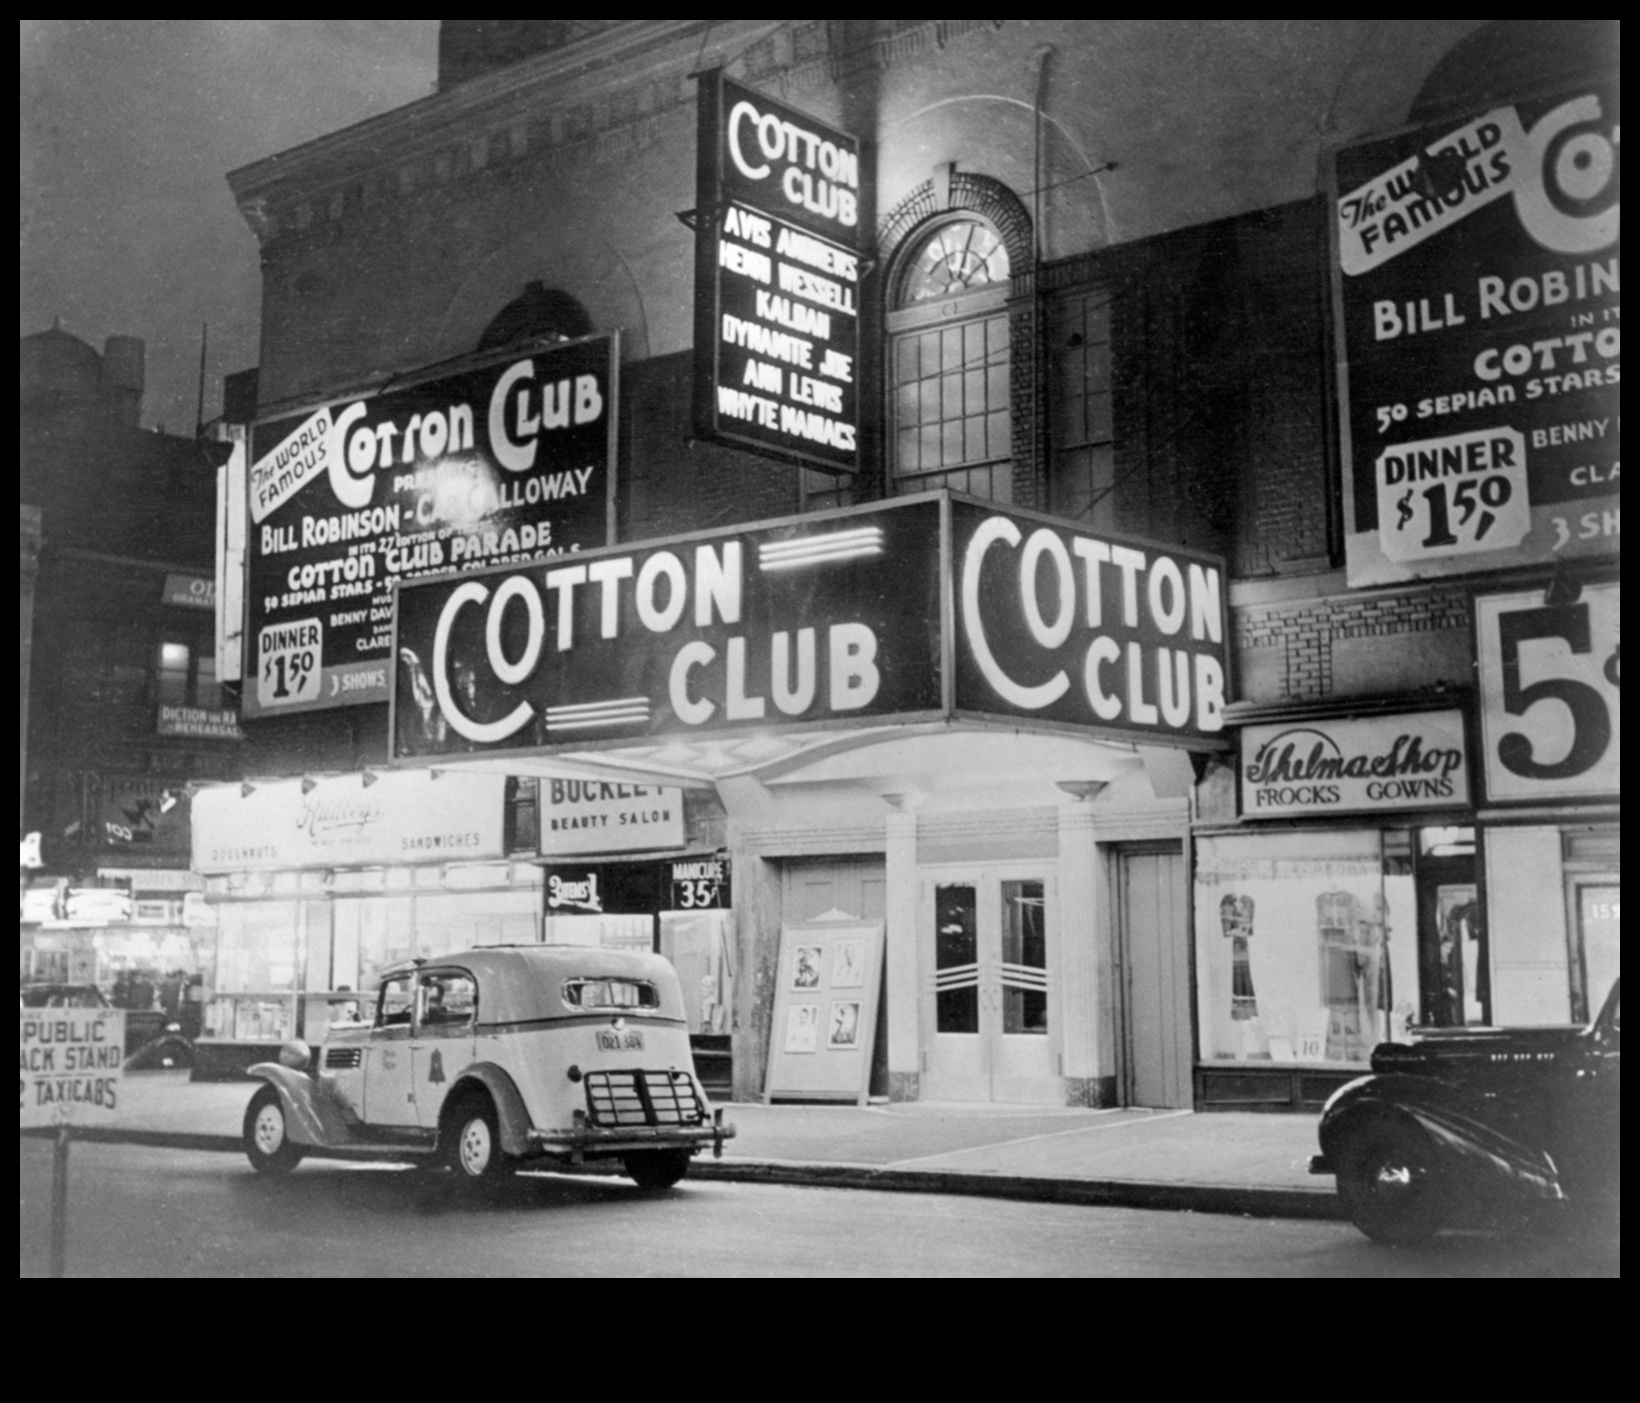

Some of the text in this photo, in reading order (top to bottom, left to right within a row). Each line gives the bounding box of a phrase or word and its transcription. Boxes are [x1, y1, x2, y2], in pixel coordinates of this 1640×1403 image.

[728, 100, 858, 188] COTTON
[783, 166, 858, 226] CLUB
[1340, 123, 1502, 229] The WLD
[1514, 95, 1620, 253] CO
[723, 207, 772, 248] AVIS
[1373, 258, 1620, 341] BILL ROBIN
[1571, 312, 1594, 328] IN
[722, 313, 853, 383] DYNAMITE JOE
[1474, 327, 1620, 381] COTTO
[717, 386, 779, 430] WHYTE
[743, 358, 843, 414] ANN LEWIS
[1376, 363, 1620, 434] 50 SEPIAN STARS
[488, 359, 603, 472] CLUB
[1532, 418, 1609, 449] BENNY
[275, 418, 328, 469] WORLD
[1385, 437, 1517, 486] DINNER
[259, 442, 327, 508] FAMOUS
[261, 525, 299, 555] BILL
[302, 504, 399, 548] ROBINSON
[1551, 517, 1570, 551] 3
[288, 521, 552, 590] COTTON CLUB PARADE
[264, 596, 278, 614] 50
[281, 588, 326, 607] SEPIAN
[330, 580, 373, 600] STARS
[330, 610, 367, 627] BENNY
[962, 516, 1222, 709] COTTON
[262, 625, 320, 654] DINNER
[433, 540, 743, 743] COTTON
[342, 669, 385, 691] SHOWS
[668, 623, 881, 725] CLUB
[1084, 636, 1226, 732] CLUB
[162, 706, 206, 723] DICTION
[1246, 730, 1463, 785] Thelma Shop
[1256, 777, 1454, 807] FROCKS GOWNS
[401, 832, 481, 850] SANDWICHES
[551, 810, 670, 831] BEAUTY SALON
[23, 1020, 105, 1044] PUBLIC
[65, 1046, 120, 1070] STAND
[34, 1077, 116, 1110] TAXICABS
